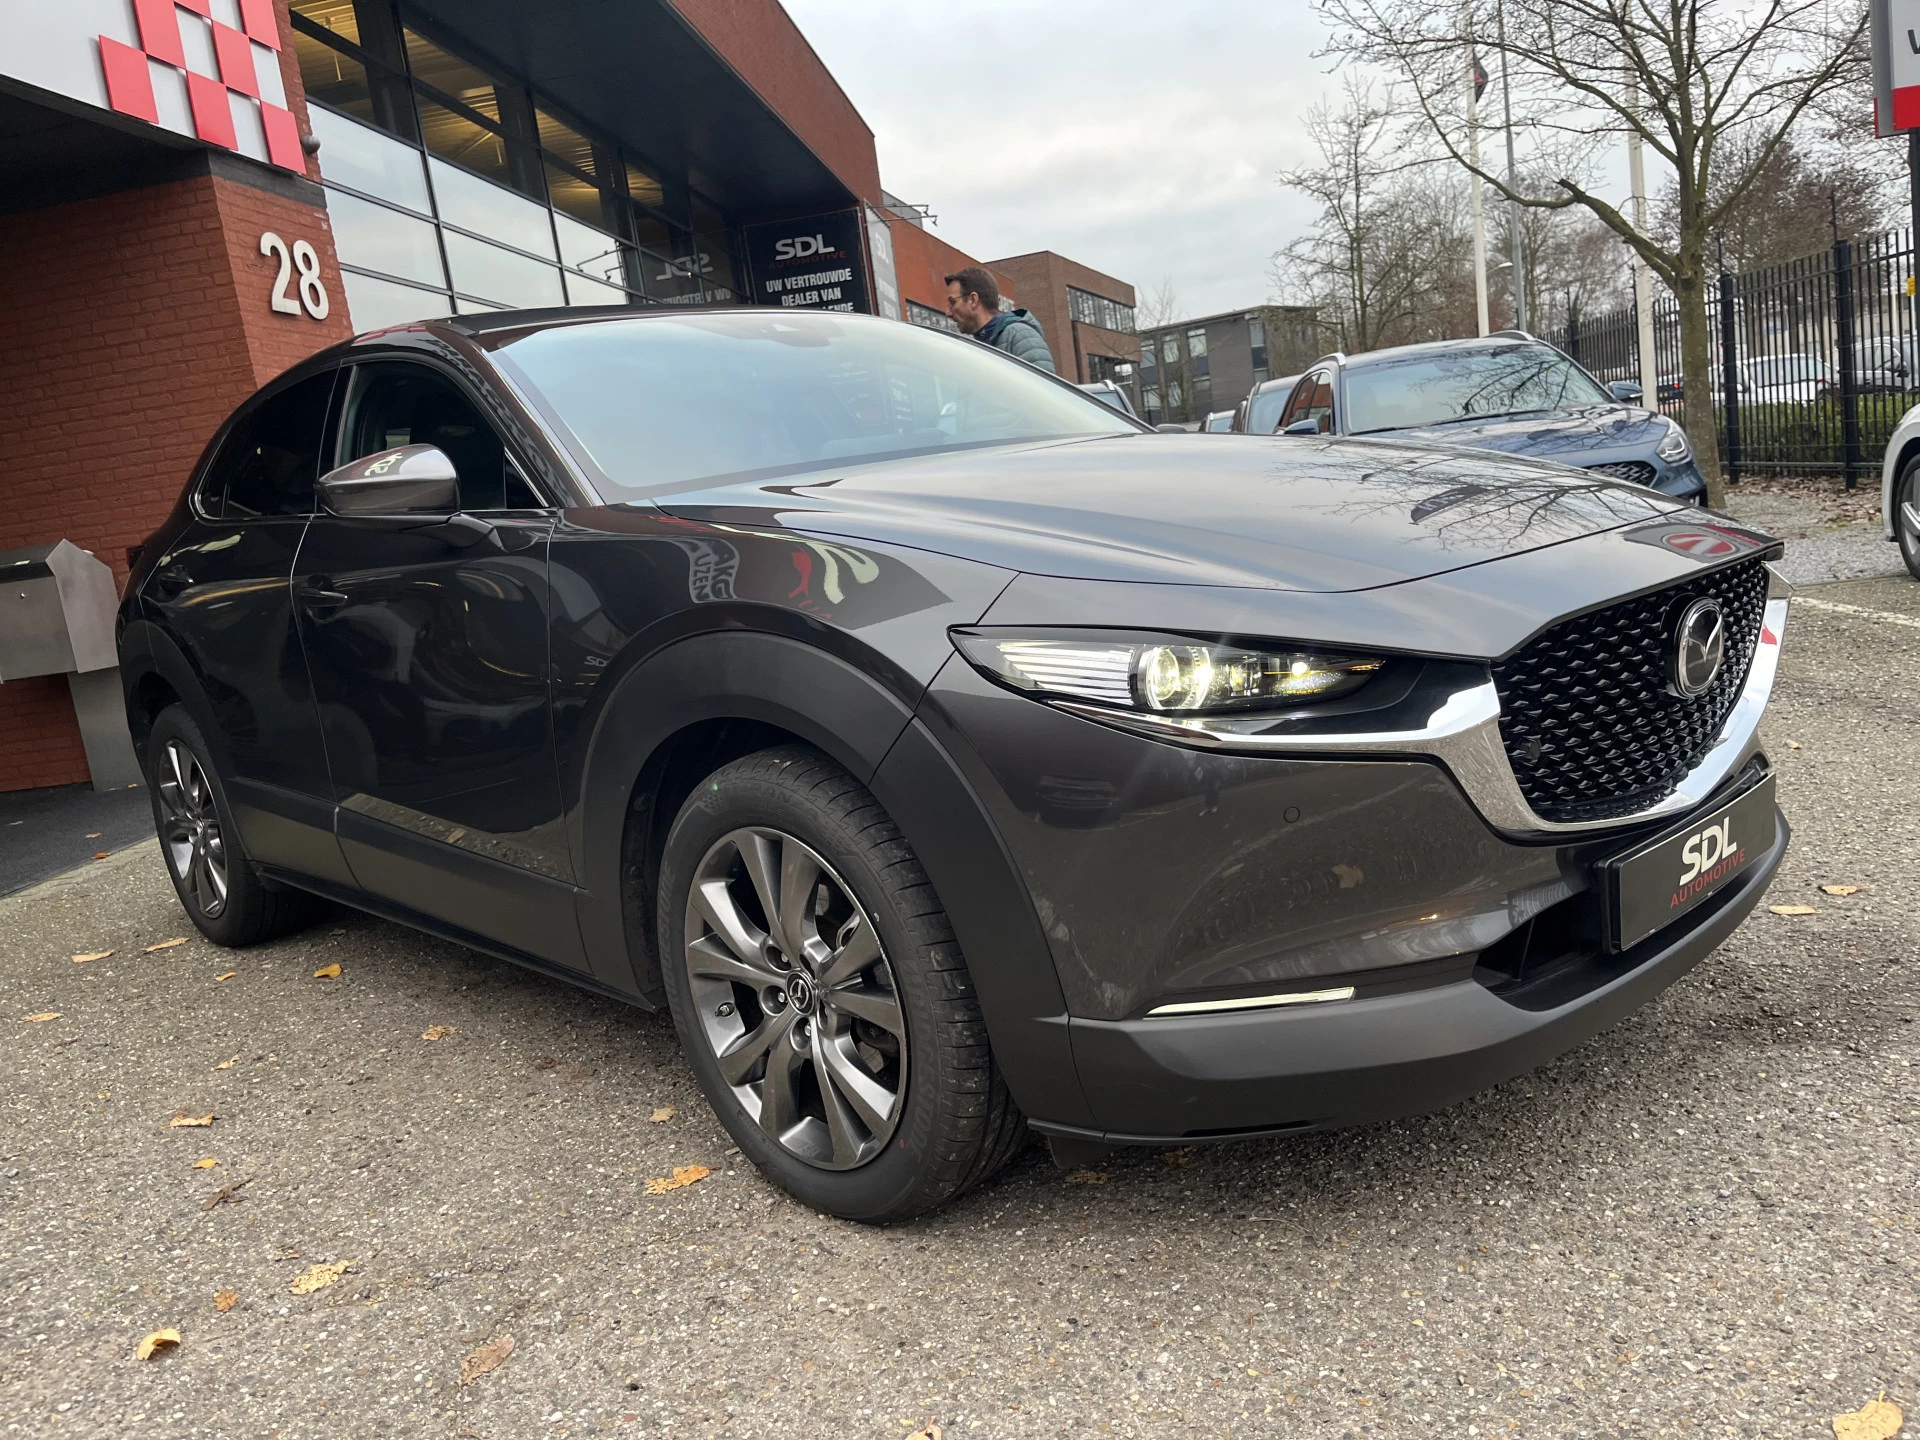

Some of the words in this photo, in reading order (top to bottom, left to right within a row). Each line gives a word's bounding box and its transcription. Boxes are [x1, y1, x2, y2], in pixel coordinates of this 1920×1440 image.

[768, 250, 846, 269] AUTOMOTIVE
[775, 233, 835, 260] SDL
[260, 232, 329, 320] 28
[766, 279, 782, 292] UW
[784, 268, 852, 290] VERTROUWDE
[781, 291, 819, 307] DEALER
[820, 287, 841, 301] VAN
[1679, 816, 1737, 886] SDL
[1670, 848, 1746, 909] AUTOMOTIVE
